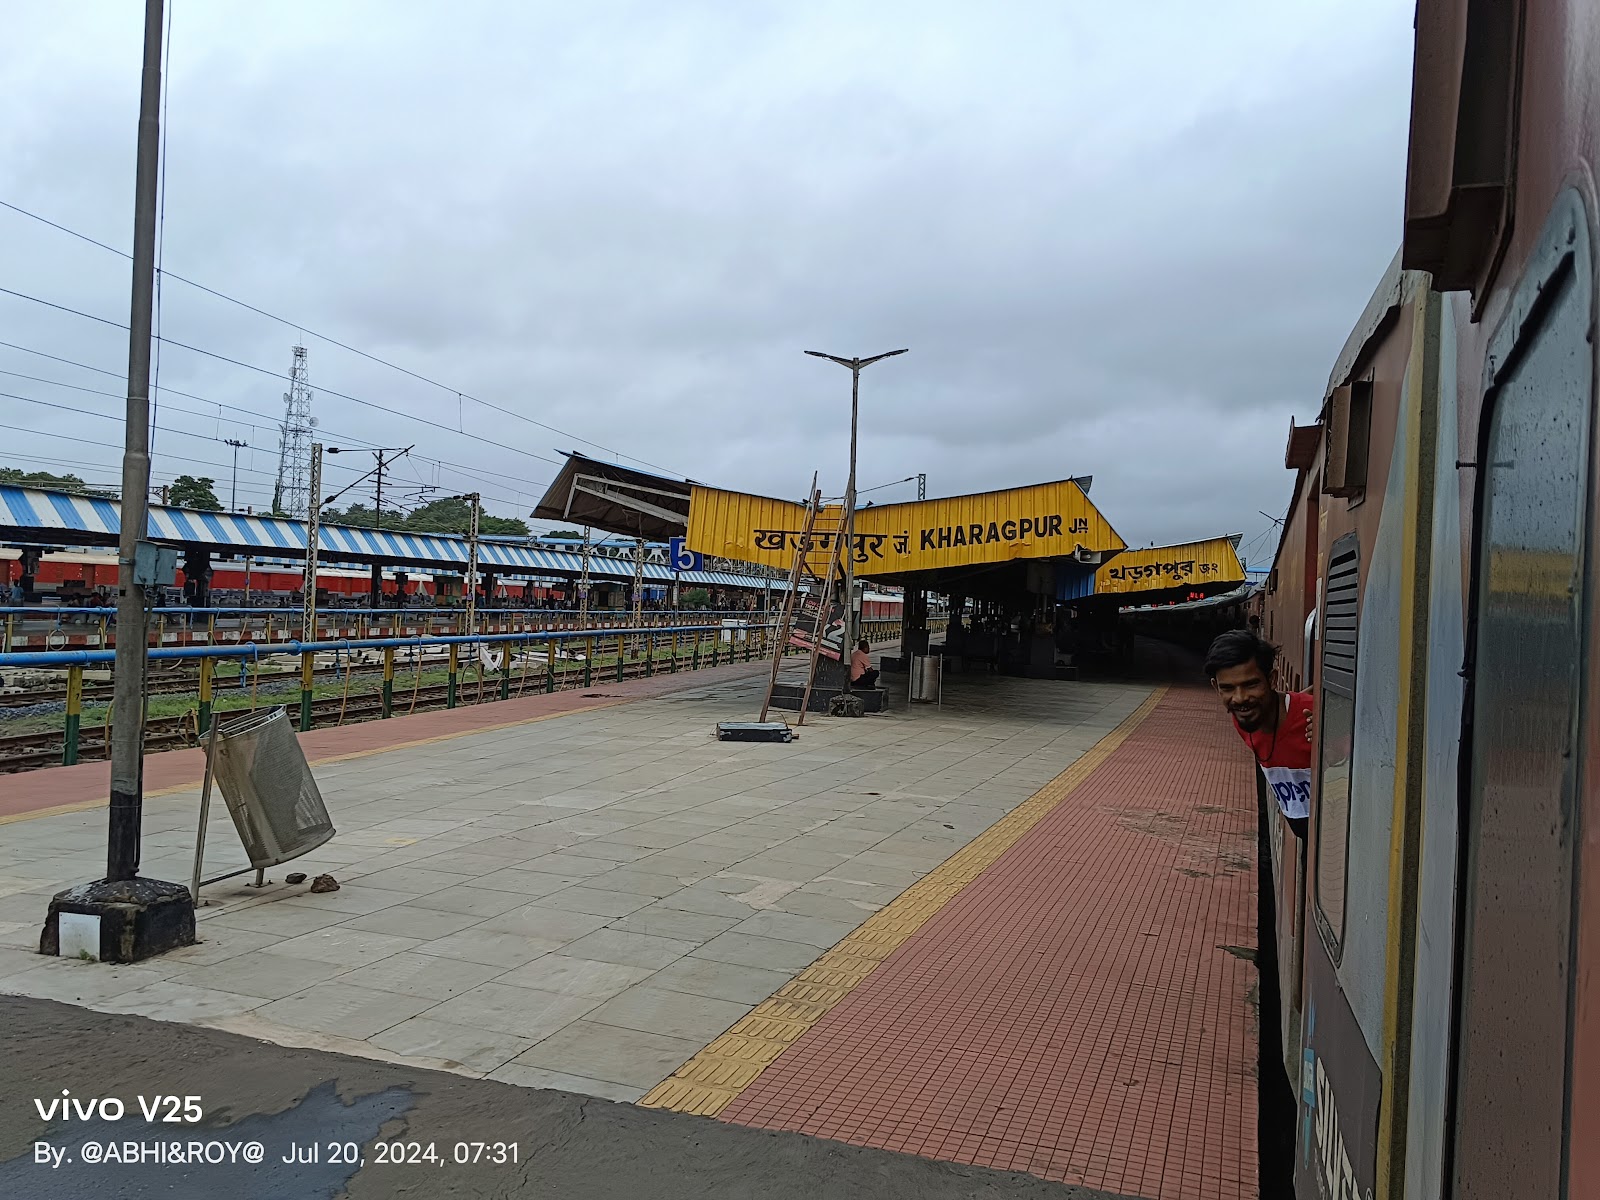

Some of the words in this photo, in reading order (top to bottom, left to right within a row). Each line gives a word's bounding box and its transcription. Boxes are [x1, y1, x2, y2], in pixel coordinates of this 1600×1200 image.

[920, 514, 1062, 551] KHARAGPUR
[677, 541, 695, 570] 5
[1109, 559, 1196, 584] খড়গপুর
